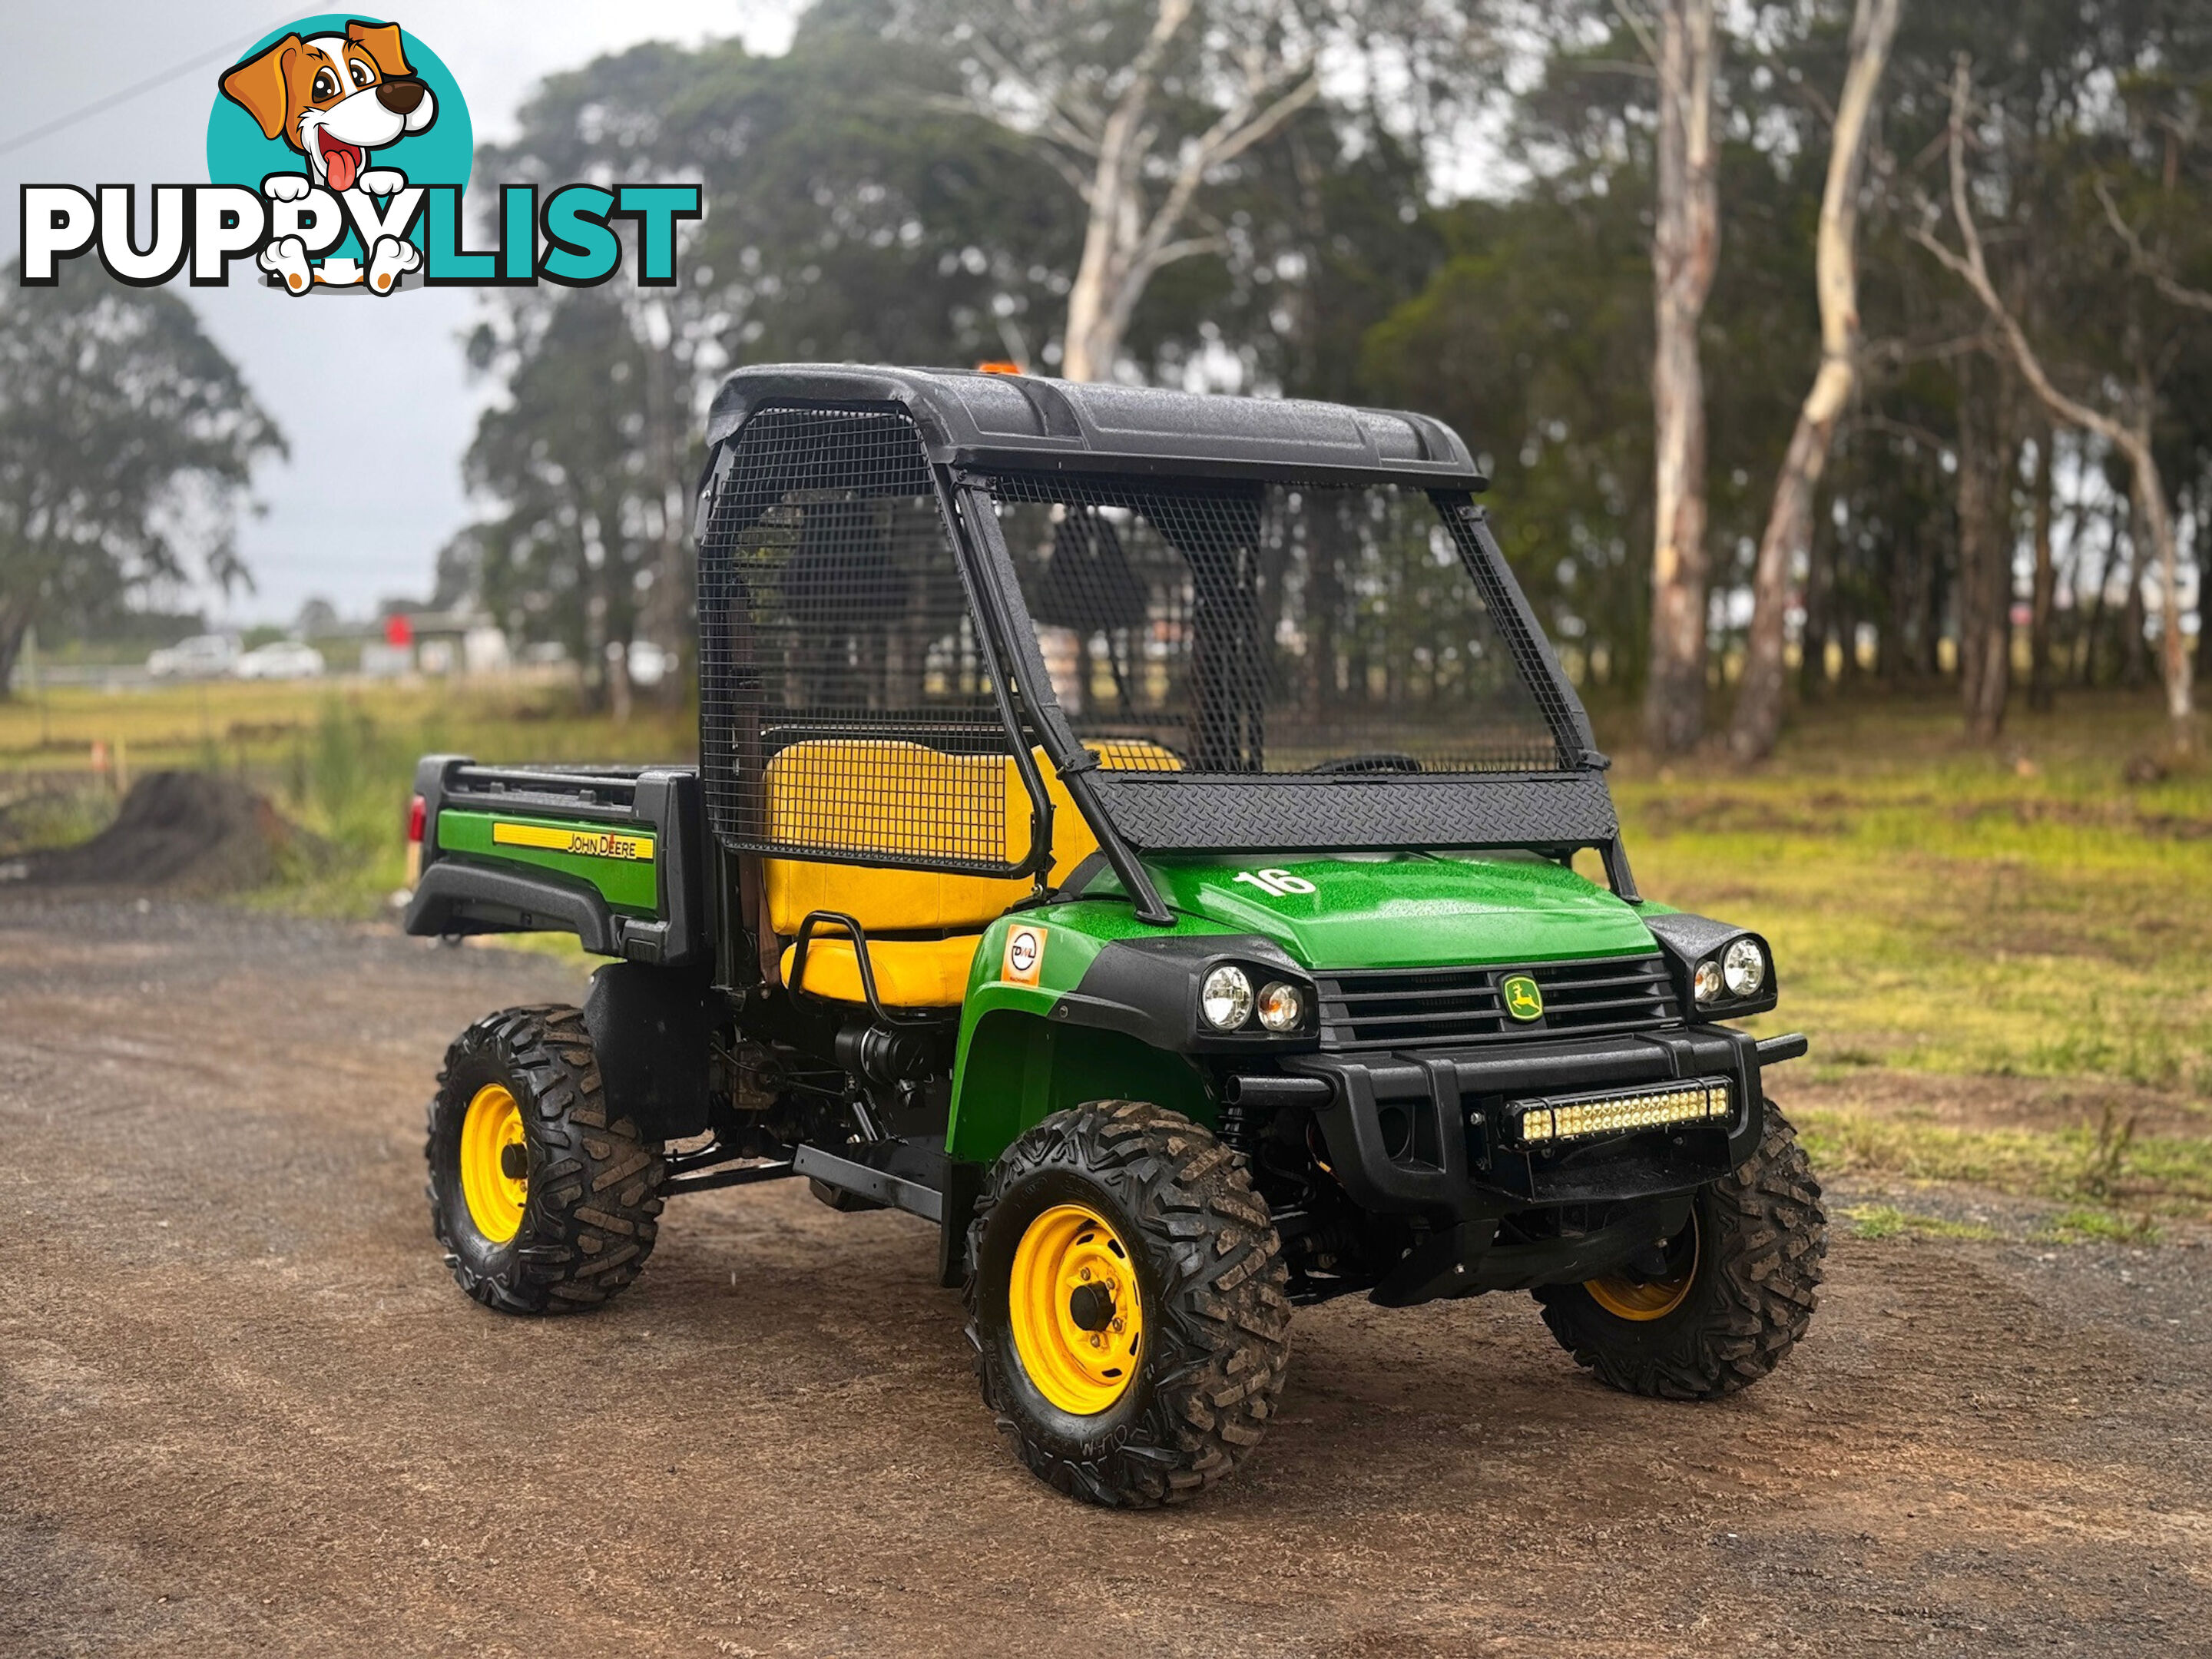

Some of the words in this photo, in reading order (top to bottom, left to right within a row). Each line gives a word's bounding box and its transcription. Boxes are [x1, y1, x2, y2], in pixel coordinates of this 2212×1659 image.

[568, 833, 598, 853] JOHN
[600, 836, 637, 856] DEERE
[1232, 869, 1316, 897] 16
